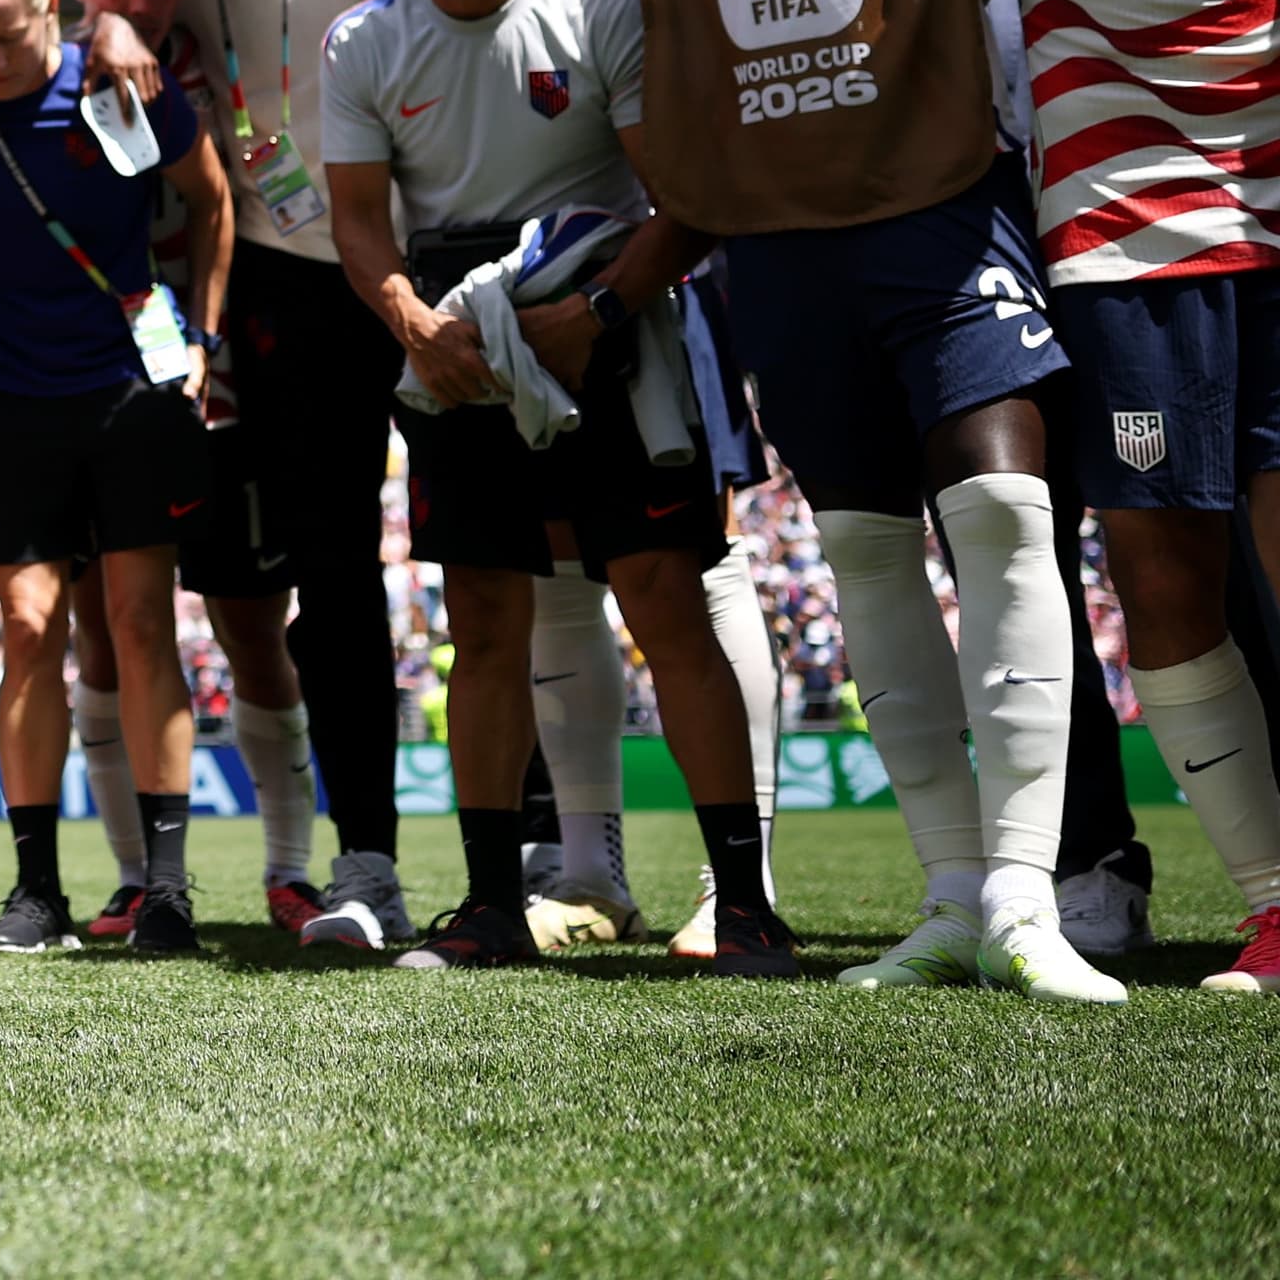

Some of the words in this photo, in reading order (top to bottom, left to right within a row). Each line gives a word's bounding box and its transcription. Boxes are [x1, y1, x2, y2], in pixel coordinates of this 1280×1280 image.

[733, 52, 810, 85] WORLD
[814, 42, 871, 69] CUP
[739, 70, 878, 125] 2026
[978, 266, 1047, 320] 2
[1117, 415, 1160, 438] USA
